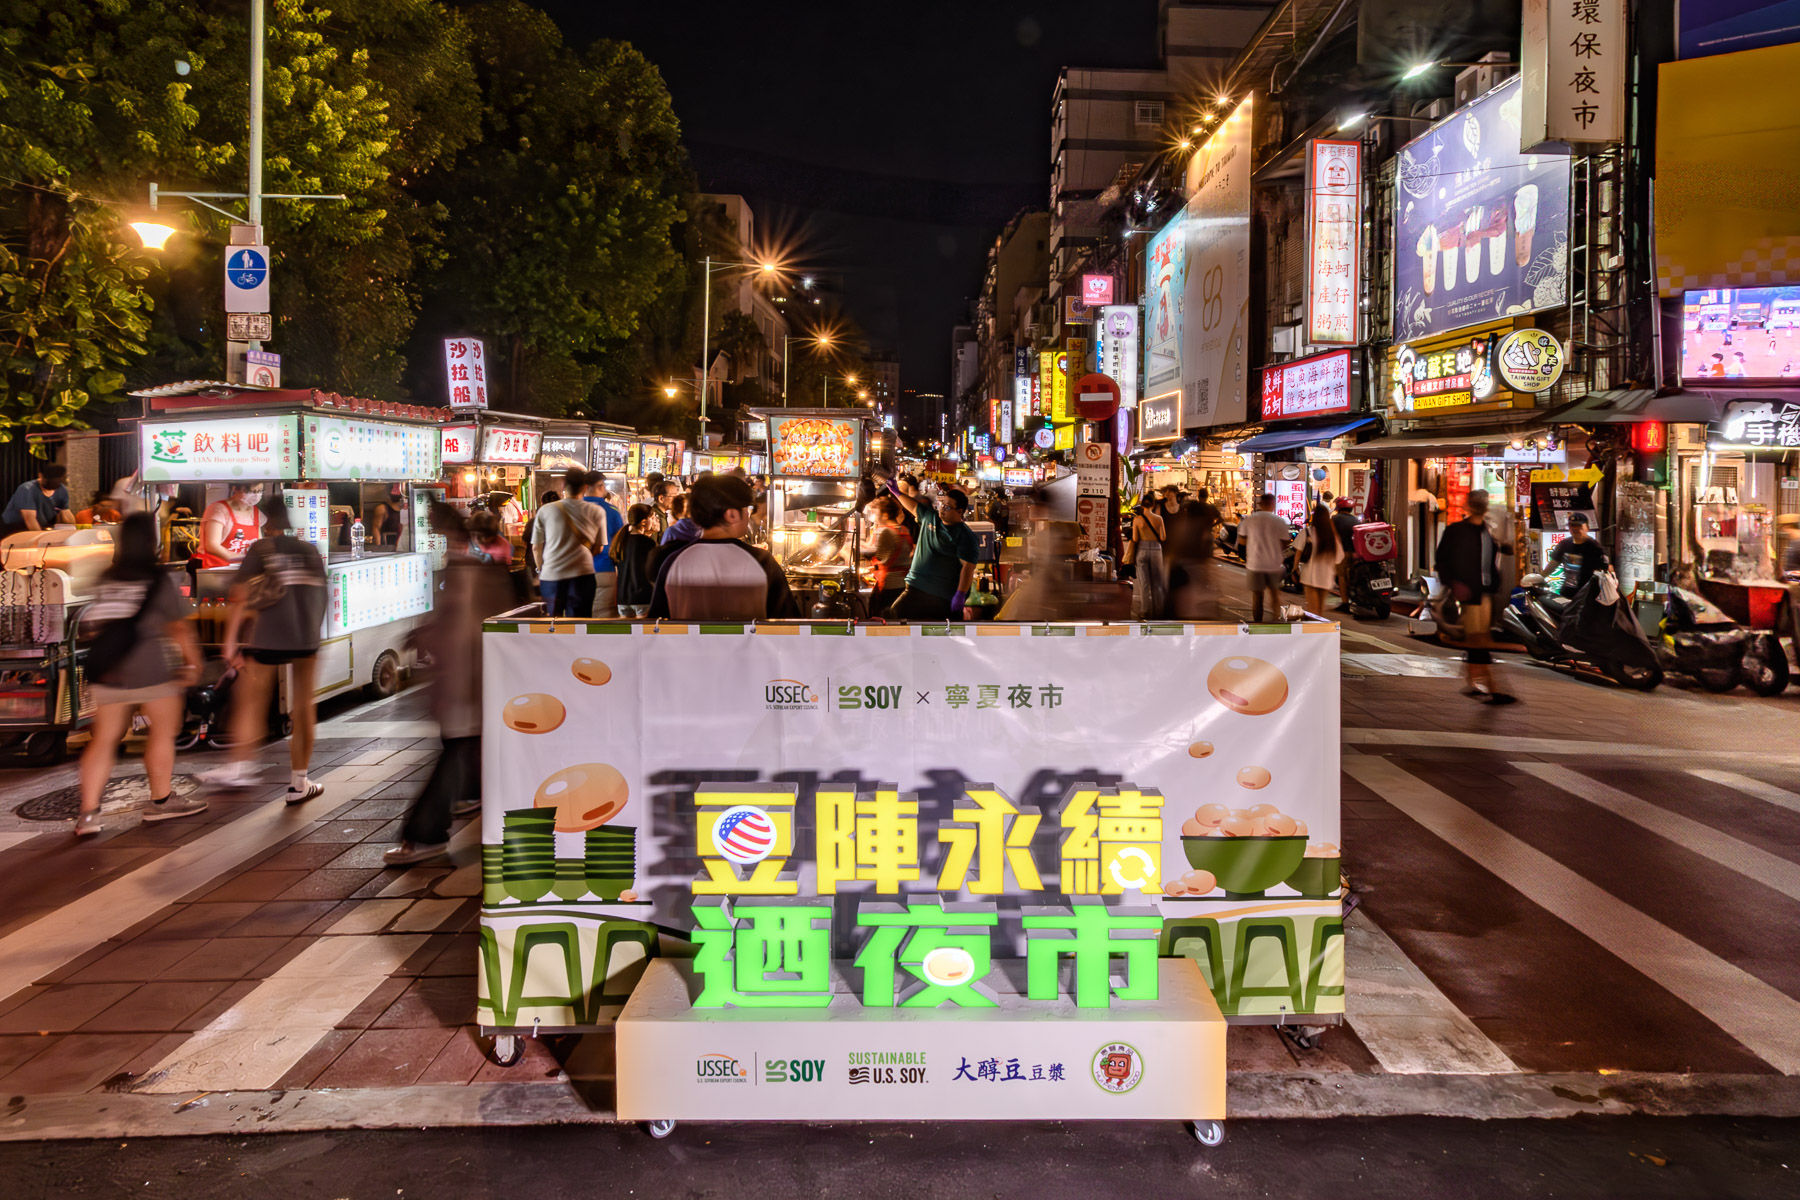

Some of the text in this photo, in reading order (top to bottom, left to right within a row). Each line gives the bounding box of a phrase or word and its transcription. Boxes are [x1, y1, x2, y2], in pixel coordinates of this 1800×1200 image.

[1568, 0, 1602, 131] 環保夜市
[450, 341, 471, 403] 沙拉船
[472, 342, 486, 404] 沙拉船
[1285, 359, 1345, 389] 鮑魚海鮮粥
[1414, 349, 1472, 380] 收藏天地
[1263, 369, 1283, 417] 東石 鮮蚵
[1414, 393, 1470, 408] TAIWAN GIFT SHOP
[193, 432, 269, 454] 飲料吧
[283, 429, 291, 463] 百年老店
[444, 438, 459, 453] 船
[504, 437, 529, 453] 沙拉船
[790, 443, 842, 465] 地瓜球
[251, 455, 270, 463] Shop
[1352, 471, 1365, 515] 東石
[1277, 494, 1290, 518] 無刺
[765, 685, 810, 704] USSEC
[864, 685, 903, 710] SOY
[945, 683, 1065, 710] 寧夏夜市
[691, 788, 1165, 895] 豆陣永續
[697, 1060, 739, 1077] USSEC
[848, 1052, 927, 1065] SUSTAINABLE
[789, 1059, 826, 1082] SOY
[873, 1067, 897, 1084] U.S.
[1125, 1071, 1140, 1088] FOOD
